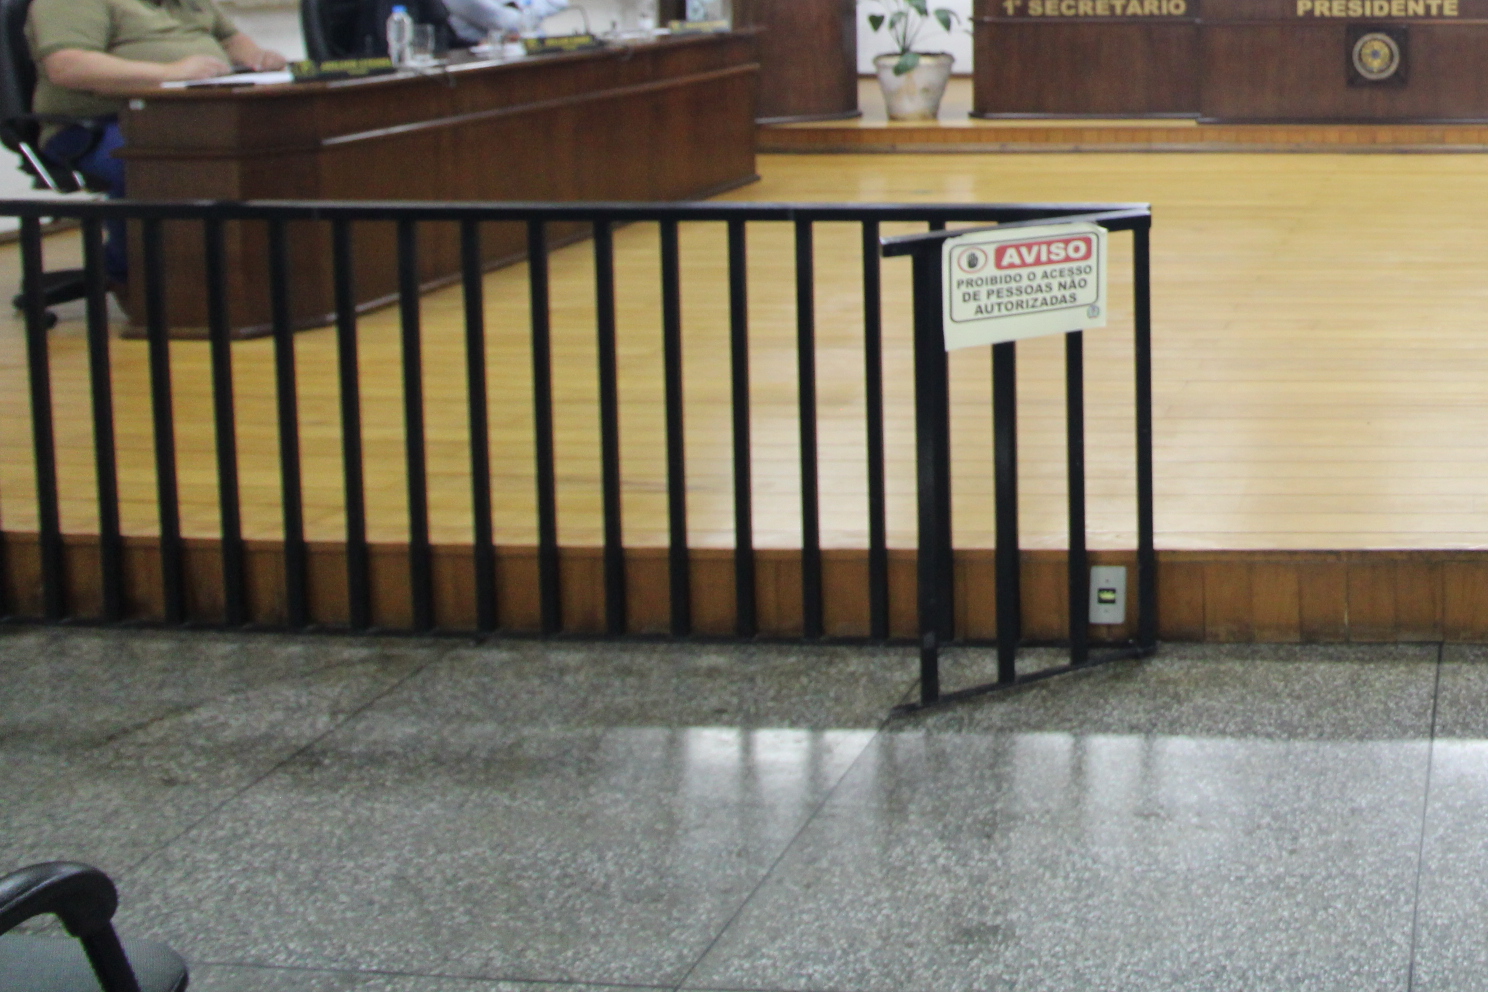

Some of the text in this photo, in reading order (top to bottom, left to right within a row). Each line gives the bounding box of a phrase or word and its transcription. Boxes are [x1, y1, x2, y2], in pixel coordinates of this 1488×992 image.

[1002, 240, 1086, 266] AVISO
[957, 265, 1093, 289] PROIBIDO O ACESSO
[962, 276, 1088, 303] DE PESSOAS NÃO
[975, 293, 1077, 316] AUTORIZADAS
